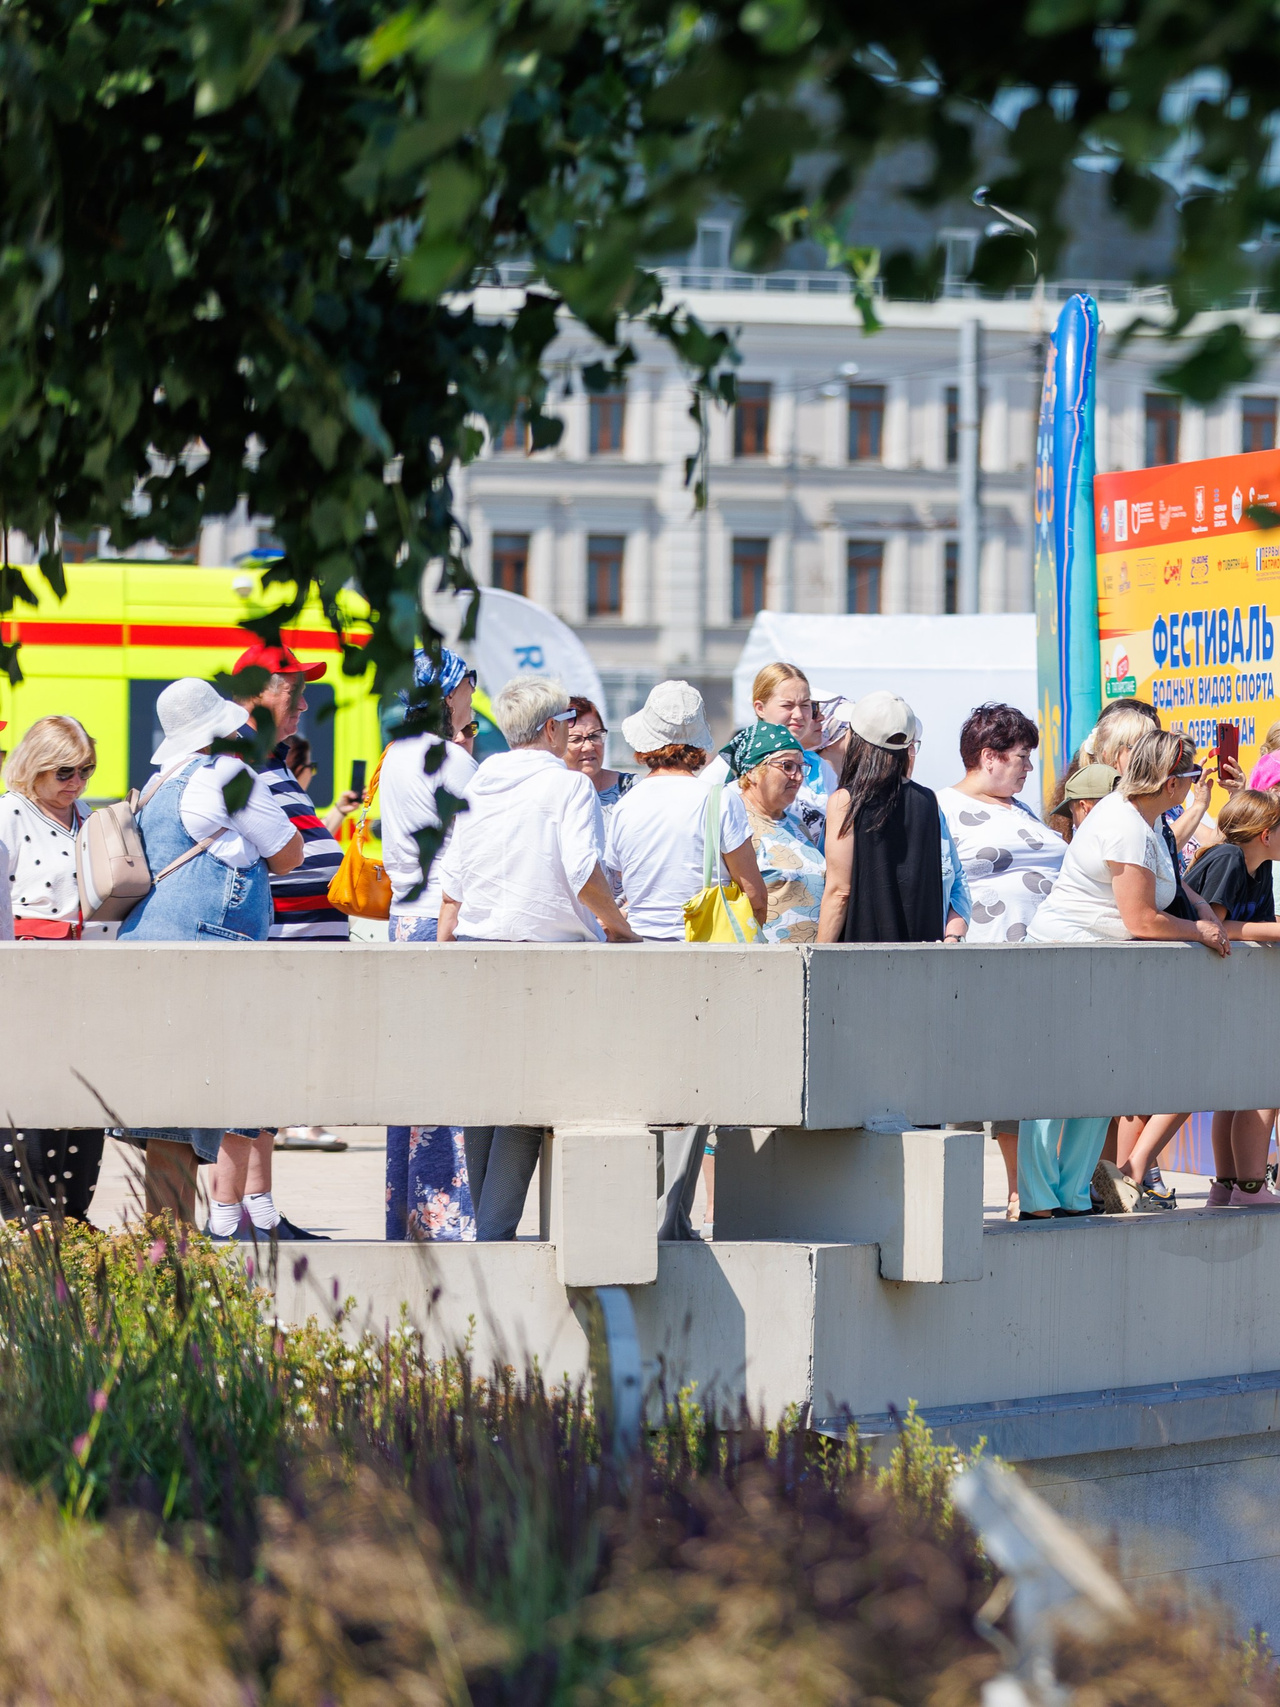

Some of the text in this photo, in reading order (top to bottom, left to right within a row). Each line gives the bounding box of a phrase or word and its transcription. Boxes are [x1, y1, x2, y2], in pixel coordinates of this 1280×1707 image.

[1152, 604, 1274, 669] ФЕСТИВАЛЬ
[1153, 672, 1274, 711] ВОДНЫХ ВИДОВ СПОРТА
